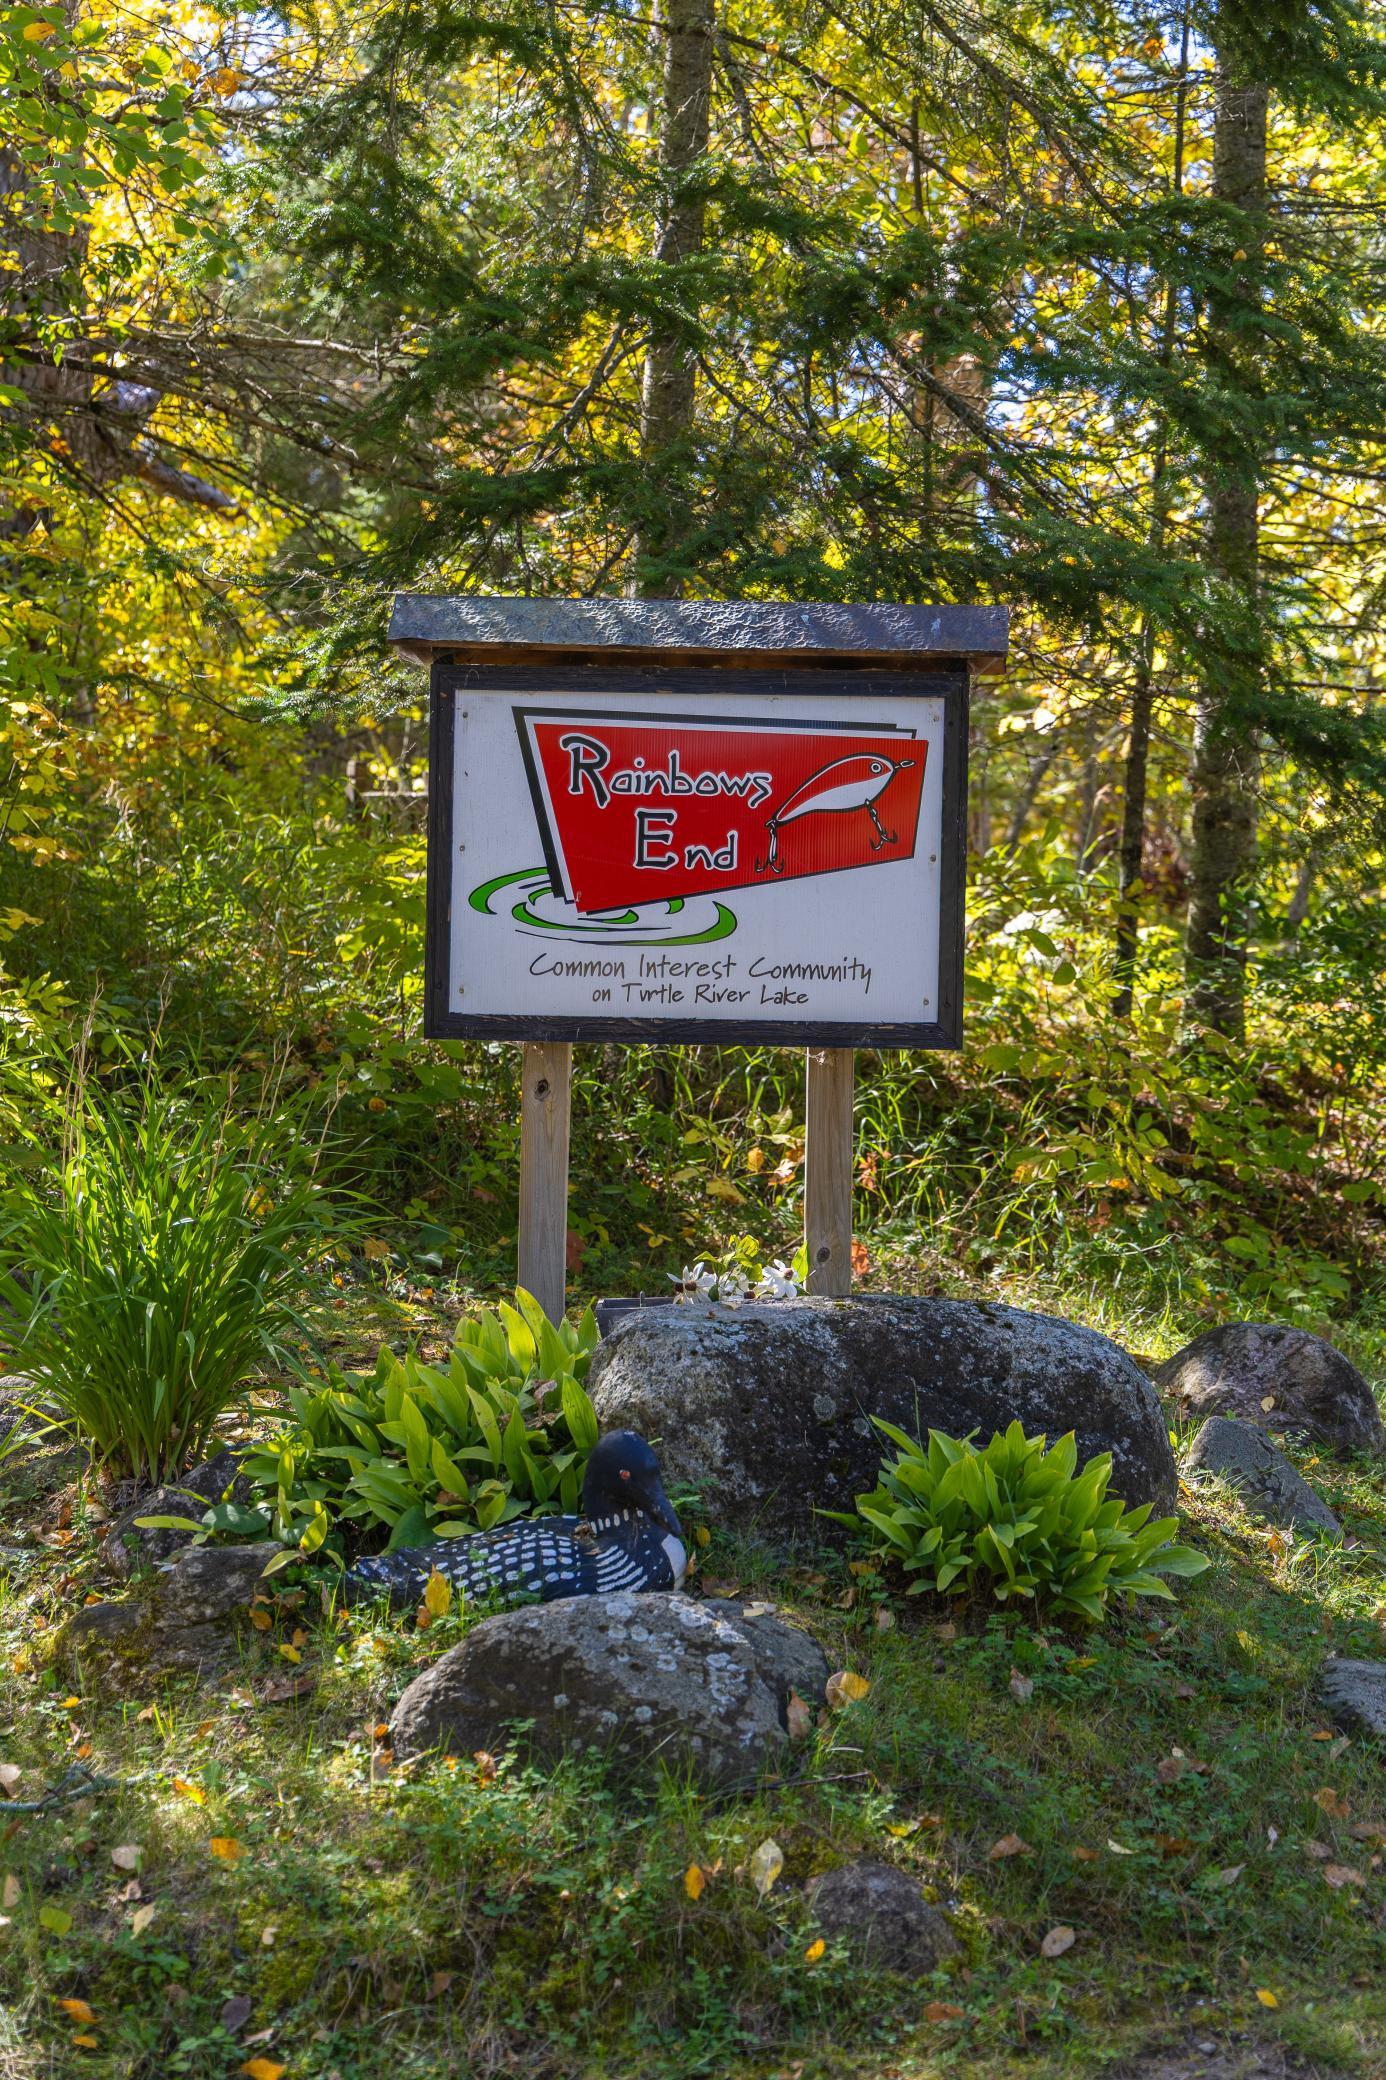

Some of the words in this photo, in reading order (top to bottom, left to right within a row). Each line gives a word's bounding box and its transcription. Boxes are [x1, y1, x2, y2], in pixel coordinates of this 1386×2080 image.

[559, 732, 773, 809] Rainbows
[633, 807, 739, 871] End
[528, 951, 626, 980] Common
[637, 952, 738, 981] Interest
[747, 954, 873, 994] Community
[591, 986, 612, 1004] on
[620, 982, 686, 1005] Turtle
[693, 983, 752, 1006] River
[758, 987, 811, 1006] Lake
